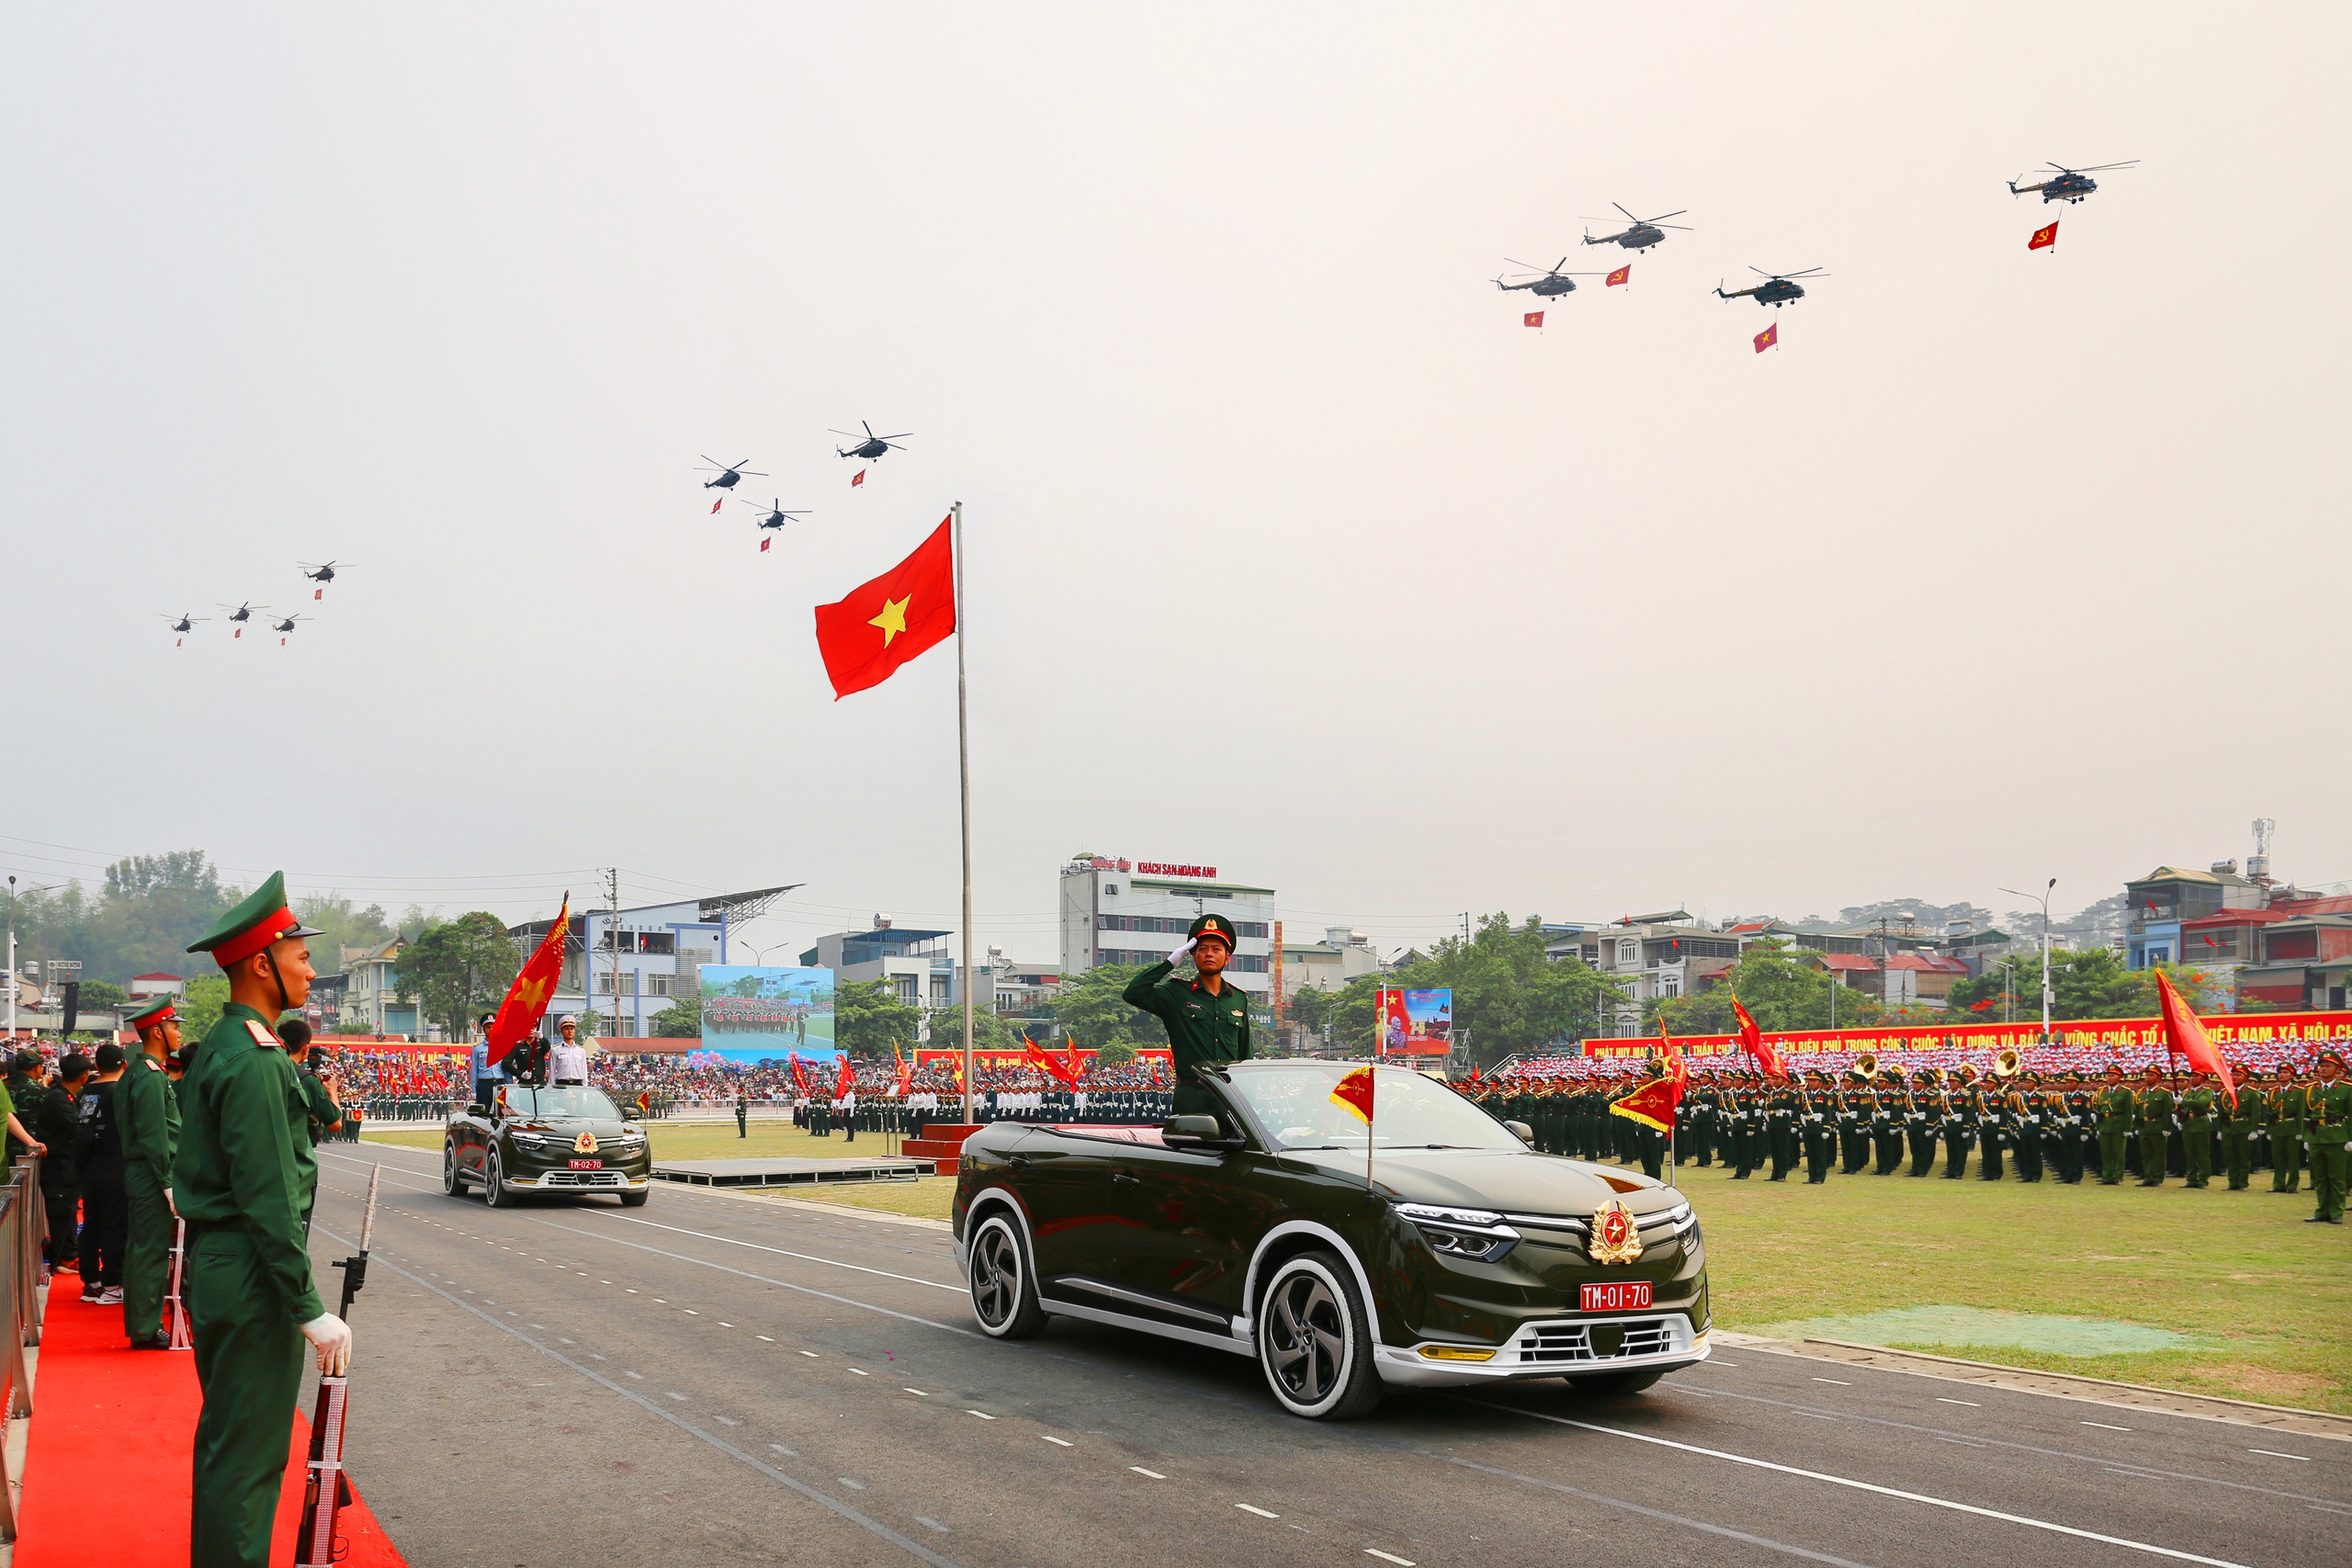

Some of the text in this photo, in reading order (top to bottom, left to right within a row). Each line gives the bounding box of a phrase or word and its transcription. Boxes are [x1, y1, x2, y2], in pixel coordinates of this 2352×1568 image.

[1202, 866, 1216, 878] ANH
[1615, 1047, 1631, 1058] HUY
[1798, 1038, 1819, 1054] BIÊN
[1822, 1035, 1842, 1052] PHỦ
[1845, 1038, 1877, 1053] TRONG
[2000, 1032, 2015, 1048] VÀ
[2064, 1029, 2098, 1047] VỮNG
[2101, 1024, 2136, 1046] CHẮC
[2141, 1023, 2158, 1046] TỔ
[2238, 1026, 2272, 1043] NAM
[2278, 1022, 2298, 1043] XÃ
[570, 1160, 602, 1169] TM-02-70
[1583, 1285, 1649, 1309] TM-01-70
